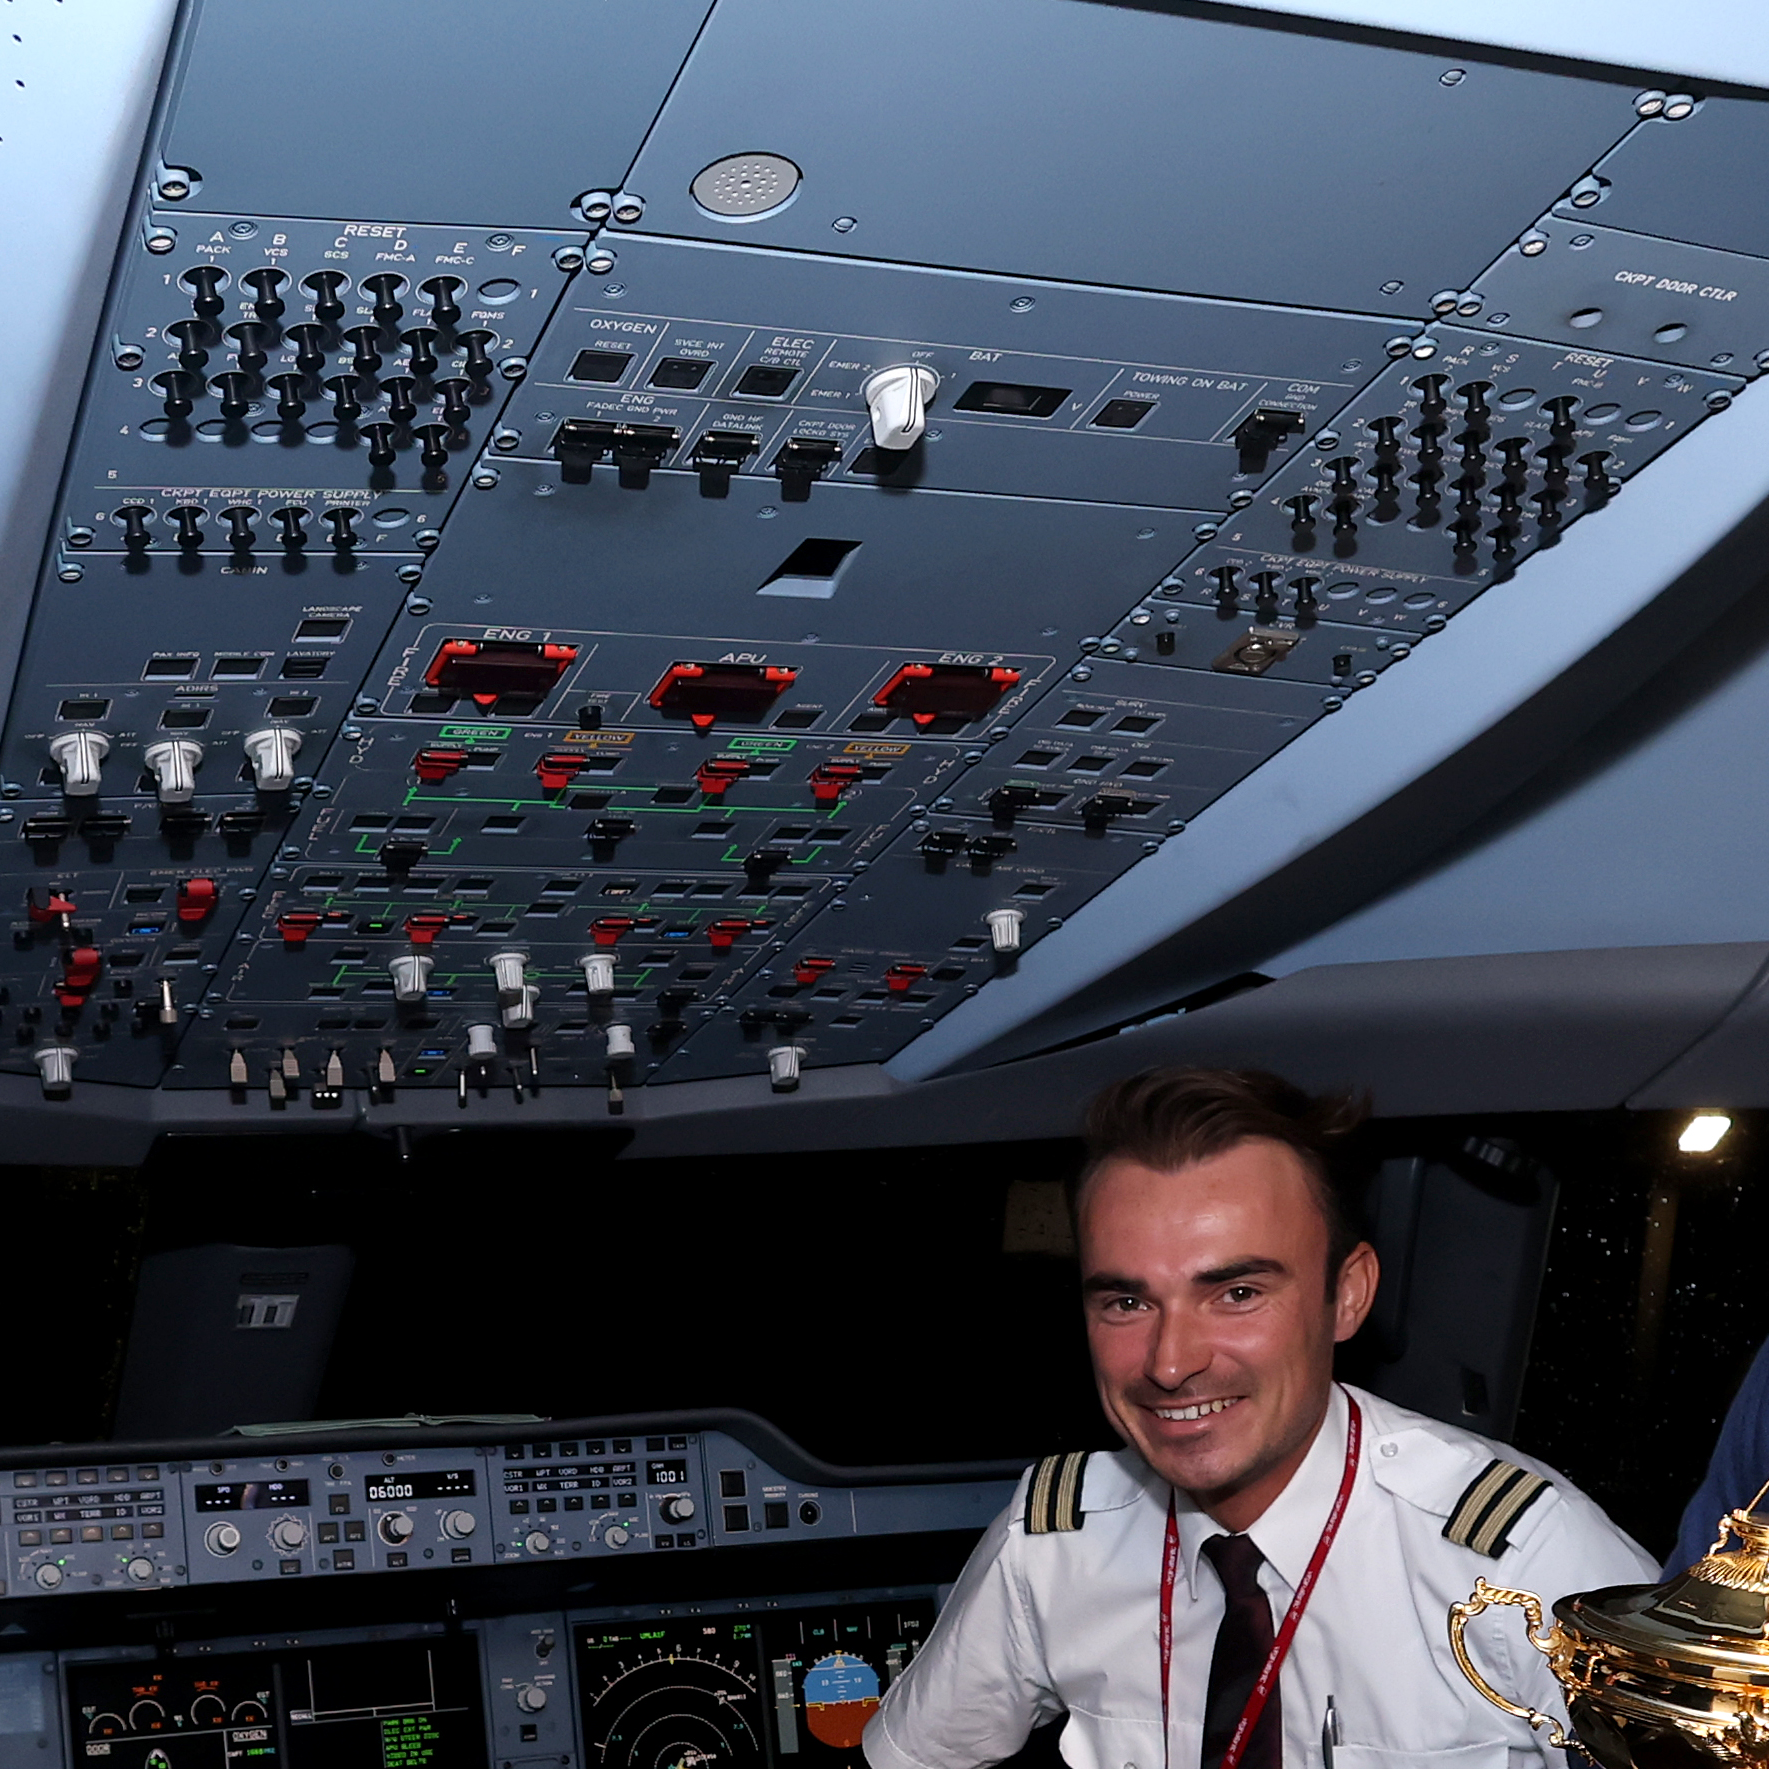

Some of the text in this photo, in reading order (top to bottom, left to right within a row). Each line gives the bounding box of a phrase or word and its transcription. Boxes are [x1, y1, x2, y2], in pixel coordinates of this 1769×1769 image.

[209, 230, 225, 243] A
[344, 224, 407, 239] RESET
[272, 233, 288, 246] B
[334, 236, 350, 249] C
[393, 239, 409, 252] D
[196, 244, 232, 255] PACK
[263, 247, 288, 257] VCS
[453, 242, 469, 254] E
[511, 245, 527, 257] F
[324, 251, 350, 260] SCS
[374, 252, 416, 263] FMC-A
[434, 255, 476, 266] FMC-C
[1614, 270, 1739, 302] CKPT DOOR CTLR
[471, 310, 506, 321] FQMS
[589, 318, 658, 335] OXYGEN
[145, 328, 158, 338] 2
[502, 339, 514, 350] 2
[594, 340, 633, 351] RESET
[674, 338, 725, 350] SVCE INT
[770, 336, 815, 350] ELEC
[679, 348, 710, 358] OVRD
[763, 346, 810, 359] REMOTE
[912, 350, 935, 360] OFF
[968, 350, 1004, 363] BAT
[758, 355, 802, 367] C/B CTL
[1564, 352, 1615, 369] RESET
[132, 377, 144, 388] 3
[1131, 370, 1250, 392] TOWING ON BAT
[1287, 382, 1321, 394] COM
[619, 393, 655, 406] ENG
[1122, 389, 1161, 400] POWER
[585, 400, 678, 417] FADEC GND PWR
[1258, 399, 1319, 411] CONNECTION
[722, 412, 765, 424] GND HF
[711, 420, 765, 432] DATALINK
[797, 419, 856, 432] CKPT DOOR
[160, 488, 383, 501] CKPT EQPT POWER SUPPLY
[1259, 552, 1295, 566] CKPT
[1295, 559, 1332, 571] EQPT
[1333, 563, 1379, 578] POWER
[482, 628, 533, 642] ENG
[213, 650, 251, 658] MOBILE
[285, 650, 337, 658] LAVATORY
[718, 652, 768, 665] APU
[938, 652, 1004, 666] ENG 2
[387, 647, 421, 687] FIRE
[174, 684, 220, 694] ADIRS
[452, 728, 500, 737] GREEN
[572, 733, 626, 742] YELLOW
[852, 745, 901, 754] YELLOW
[535, 1468, 552, 1478] WPT
[611, 1463, 632, 1473] ARPT
[383, 1476, 396, 1485] ALT
[501, 1469, 523, 1480] CSTR
[656, 1470, 686, 1484] 1001
[502, 1483, 524, 1493] VOR1
[559, 1480, 579, 1490] TERR
[591, 1479, 601, 1489] ID
[612, 1477, 633, 1487] VOR2
[216, 1485, 231, 1495] SPD
[369, 1484, 413, 1500] 06000
[232, 1730, 268, 1743] OXYGEN
